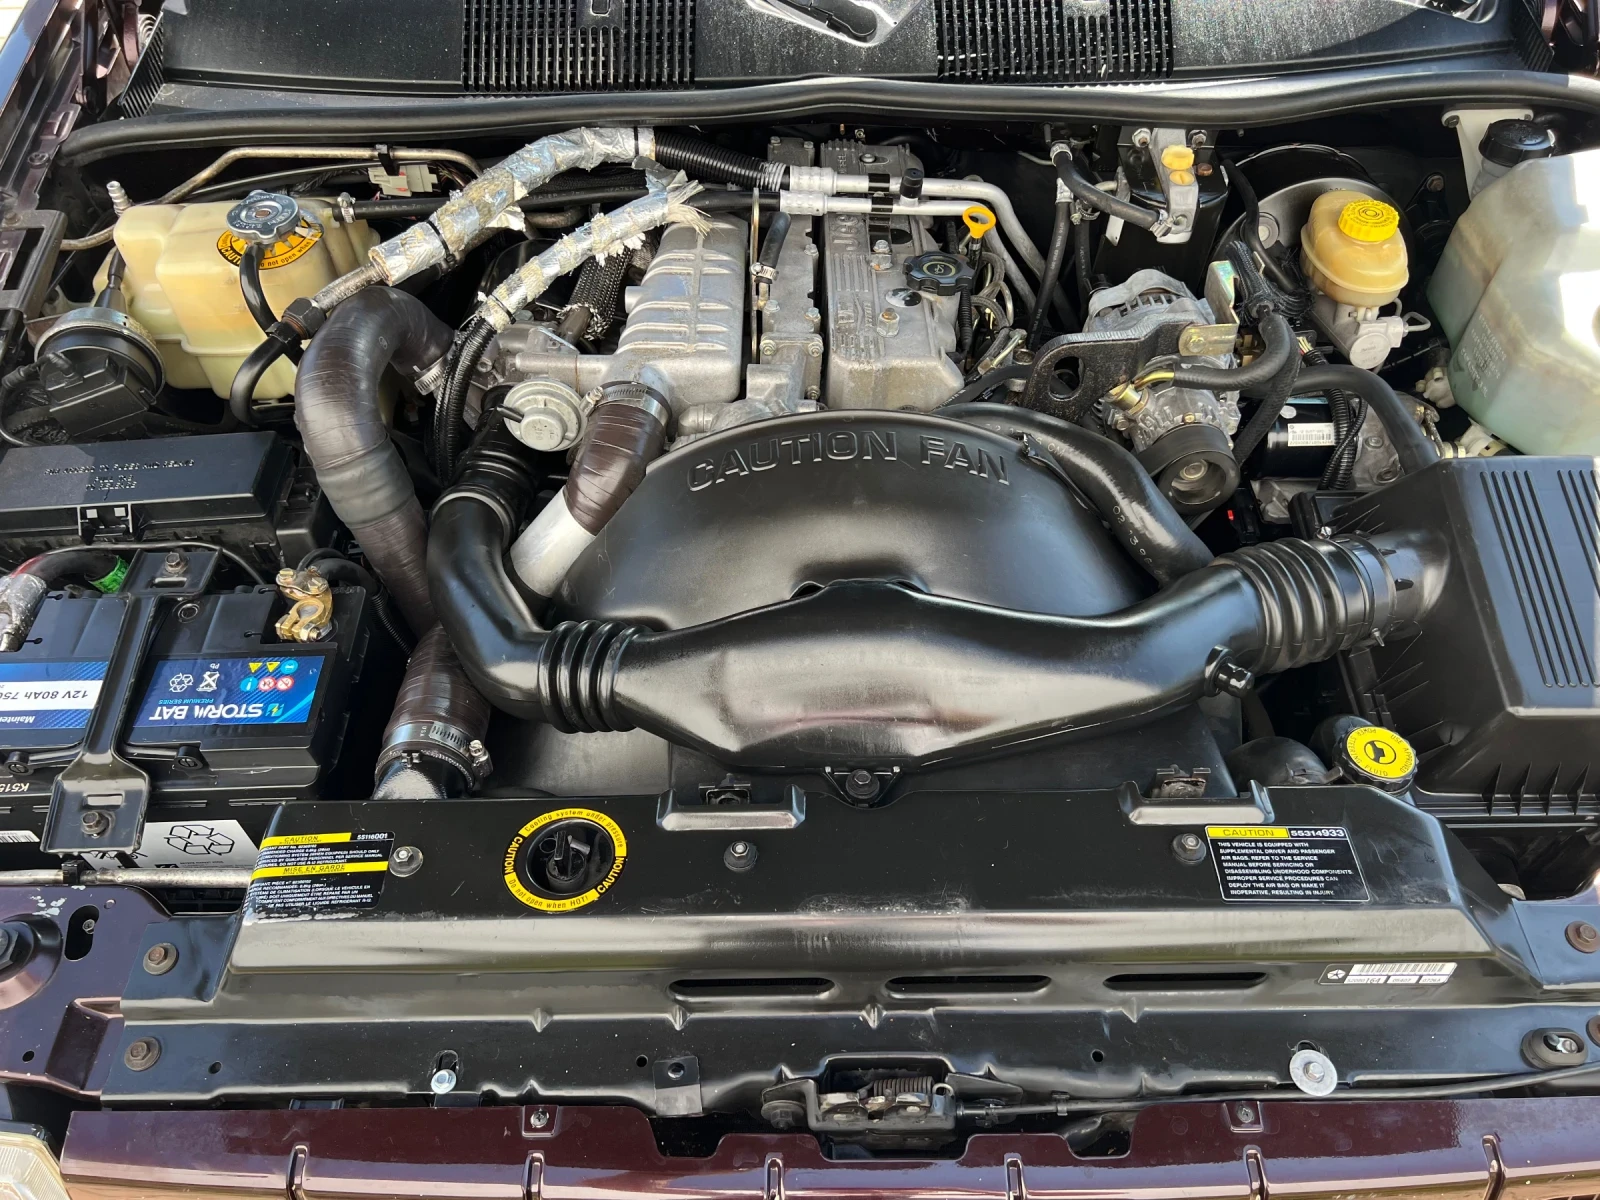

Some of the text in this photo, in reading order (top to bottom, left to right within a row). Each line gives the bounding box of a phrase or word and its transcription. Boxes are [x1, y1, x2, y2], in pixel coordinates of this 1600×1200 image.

[221, 245, 241, 265] CAUTI
[280, 252, 296, 264] open
[687, 430, 897, 492] CAUTION
[919, 434, 1010, 486] FAN
[0, 690, 89, 700] 12V 80Ah 75
[149, 703, 264, 721] STORM BAT
[1390, 734, 1404, 745] USE
[1364, 764, 1389, 777] FLUID
[524, 809, 624, 849] Cooling system under pressure
[1222, 828, 1346, 838] CAUTION 55314933
[504, 836, 523, 873] CAUTION
[284, 866, 305, 874] MISE
[306, 865, 318, 873] EN
[320, 864, 346, 872] GARDE
[596, 856, 625, 894] CAUTION
[507, 878, 589, 910] Do not open when HOT!
